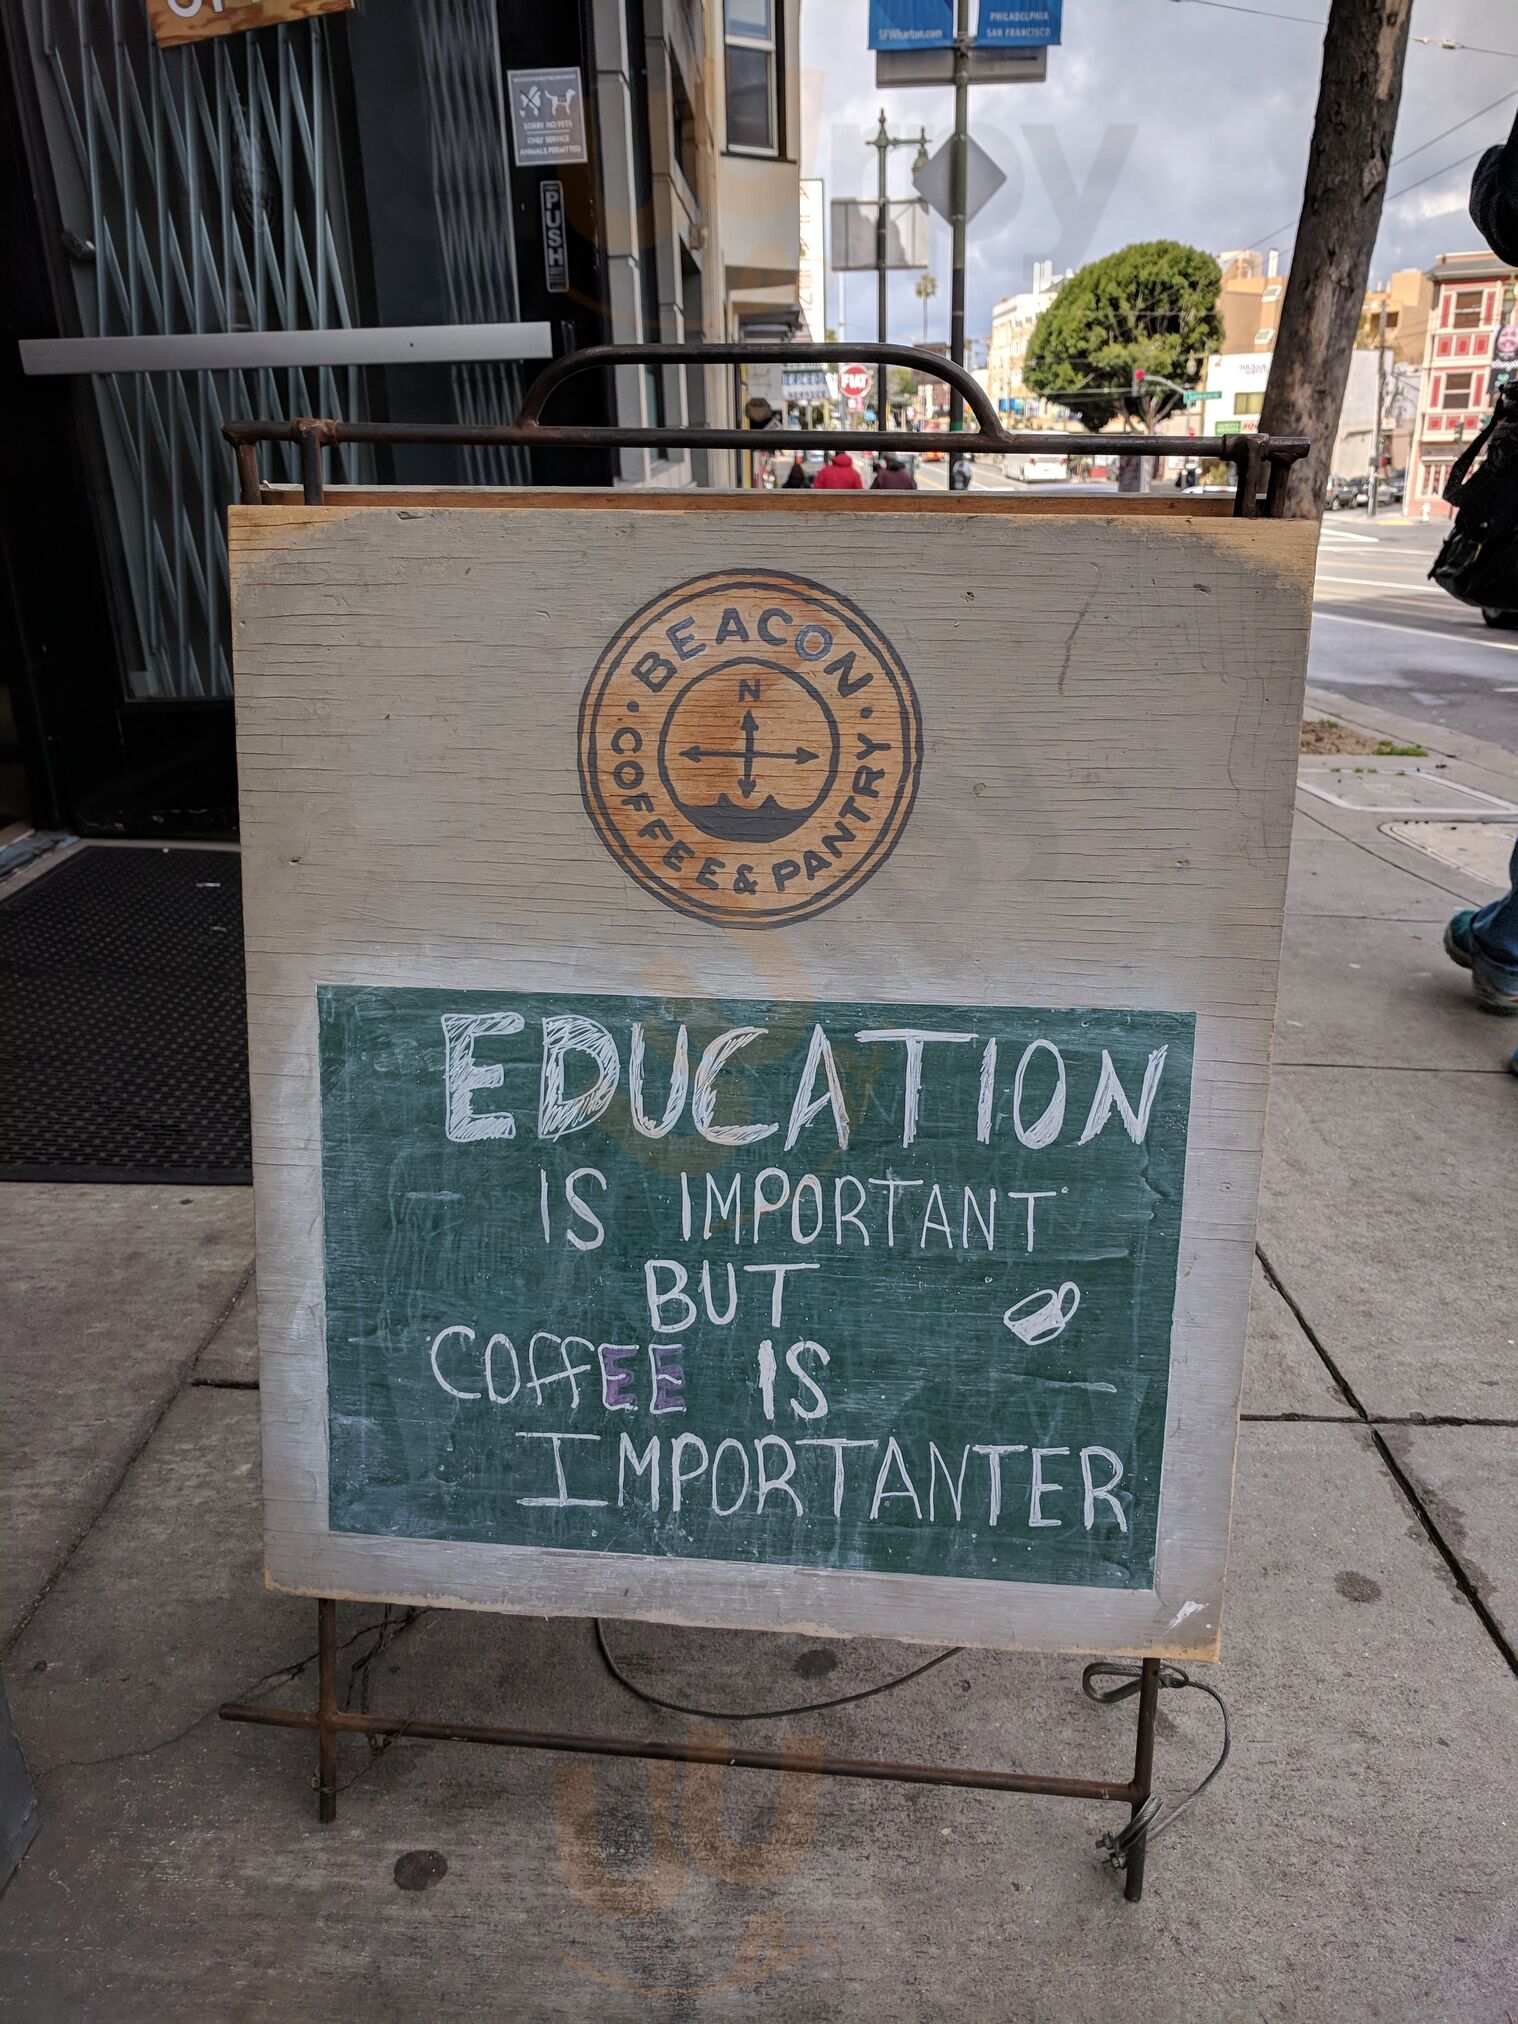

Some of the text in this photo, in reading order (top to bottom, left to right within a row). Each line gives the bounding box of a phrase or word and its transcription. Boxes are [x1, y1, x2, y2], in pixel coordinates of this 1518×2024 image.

[986, 27, 1052, 38] SAN FRANCISCO
[988, 11, 1050, 21] PHILADELPHIA
[545, 121, 557, 129] NO
[547, 145, 582, 154] PERMITTED
[545, 190, 564, 266] PUSH
[631, 607, 874, 698] BEACON
[738, 679, 761, 703] N
[610, 726, 726, 891] COFFEE
[732, 863, 757, 896] &
[771, 732, 892, 893] PANTRY
[440, 1011, 1169, 1152] EDUCATION
[539, 1166, 1060, 1253] IS IMPORTANT
[645, 1259, 820, 1334] BUT
[757, 1338, 831, 1420] IS
[515, 1431, 1130, 1533] IMPORTANTER
